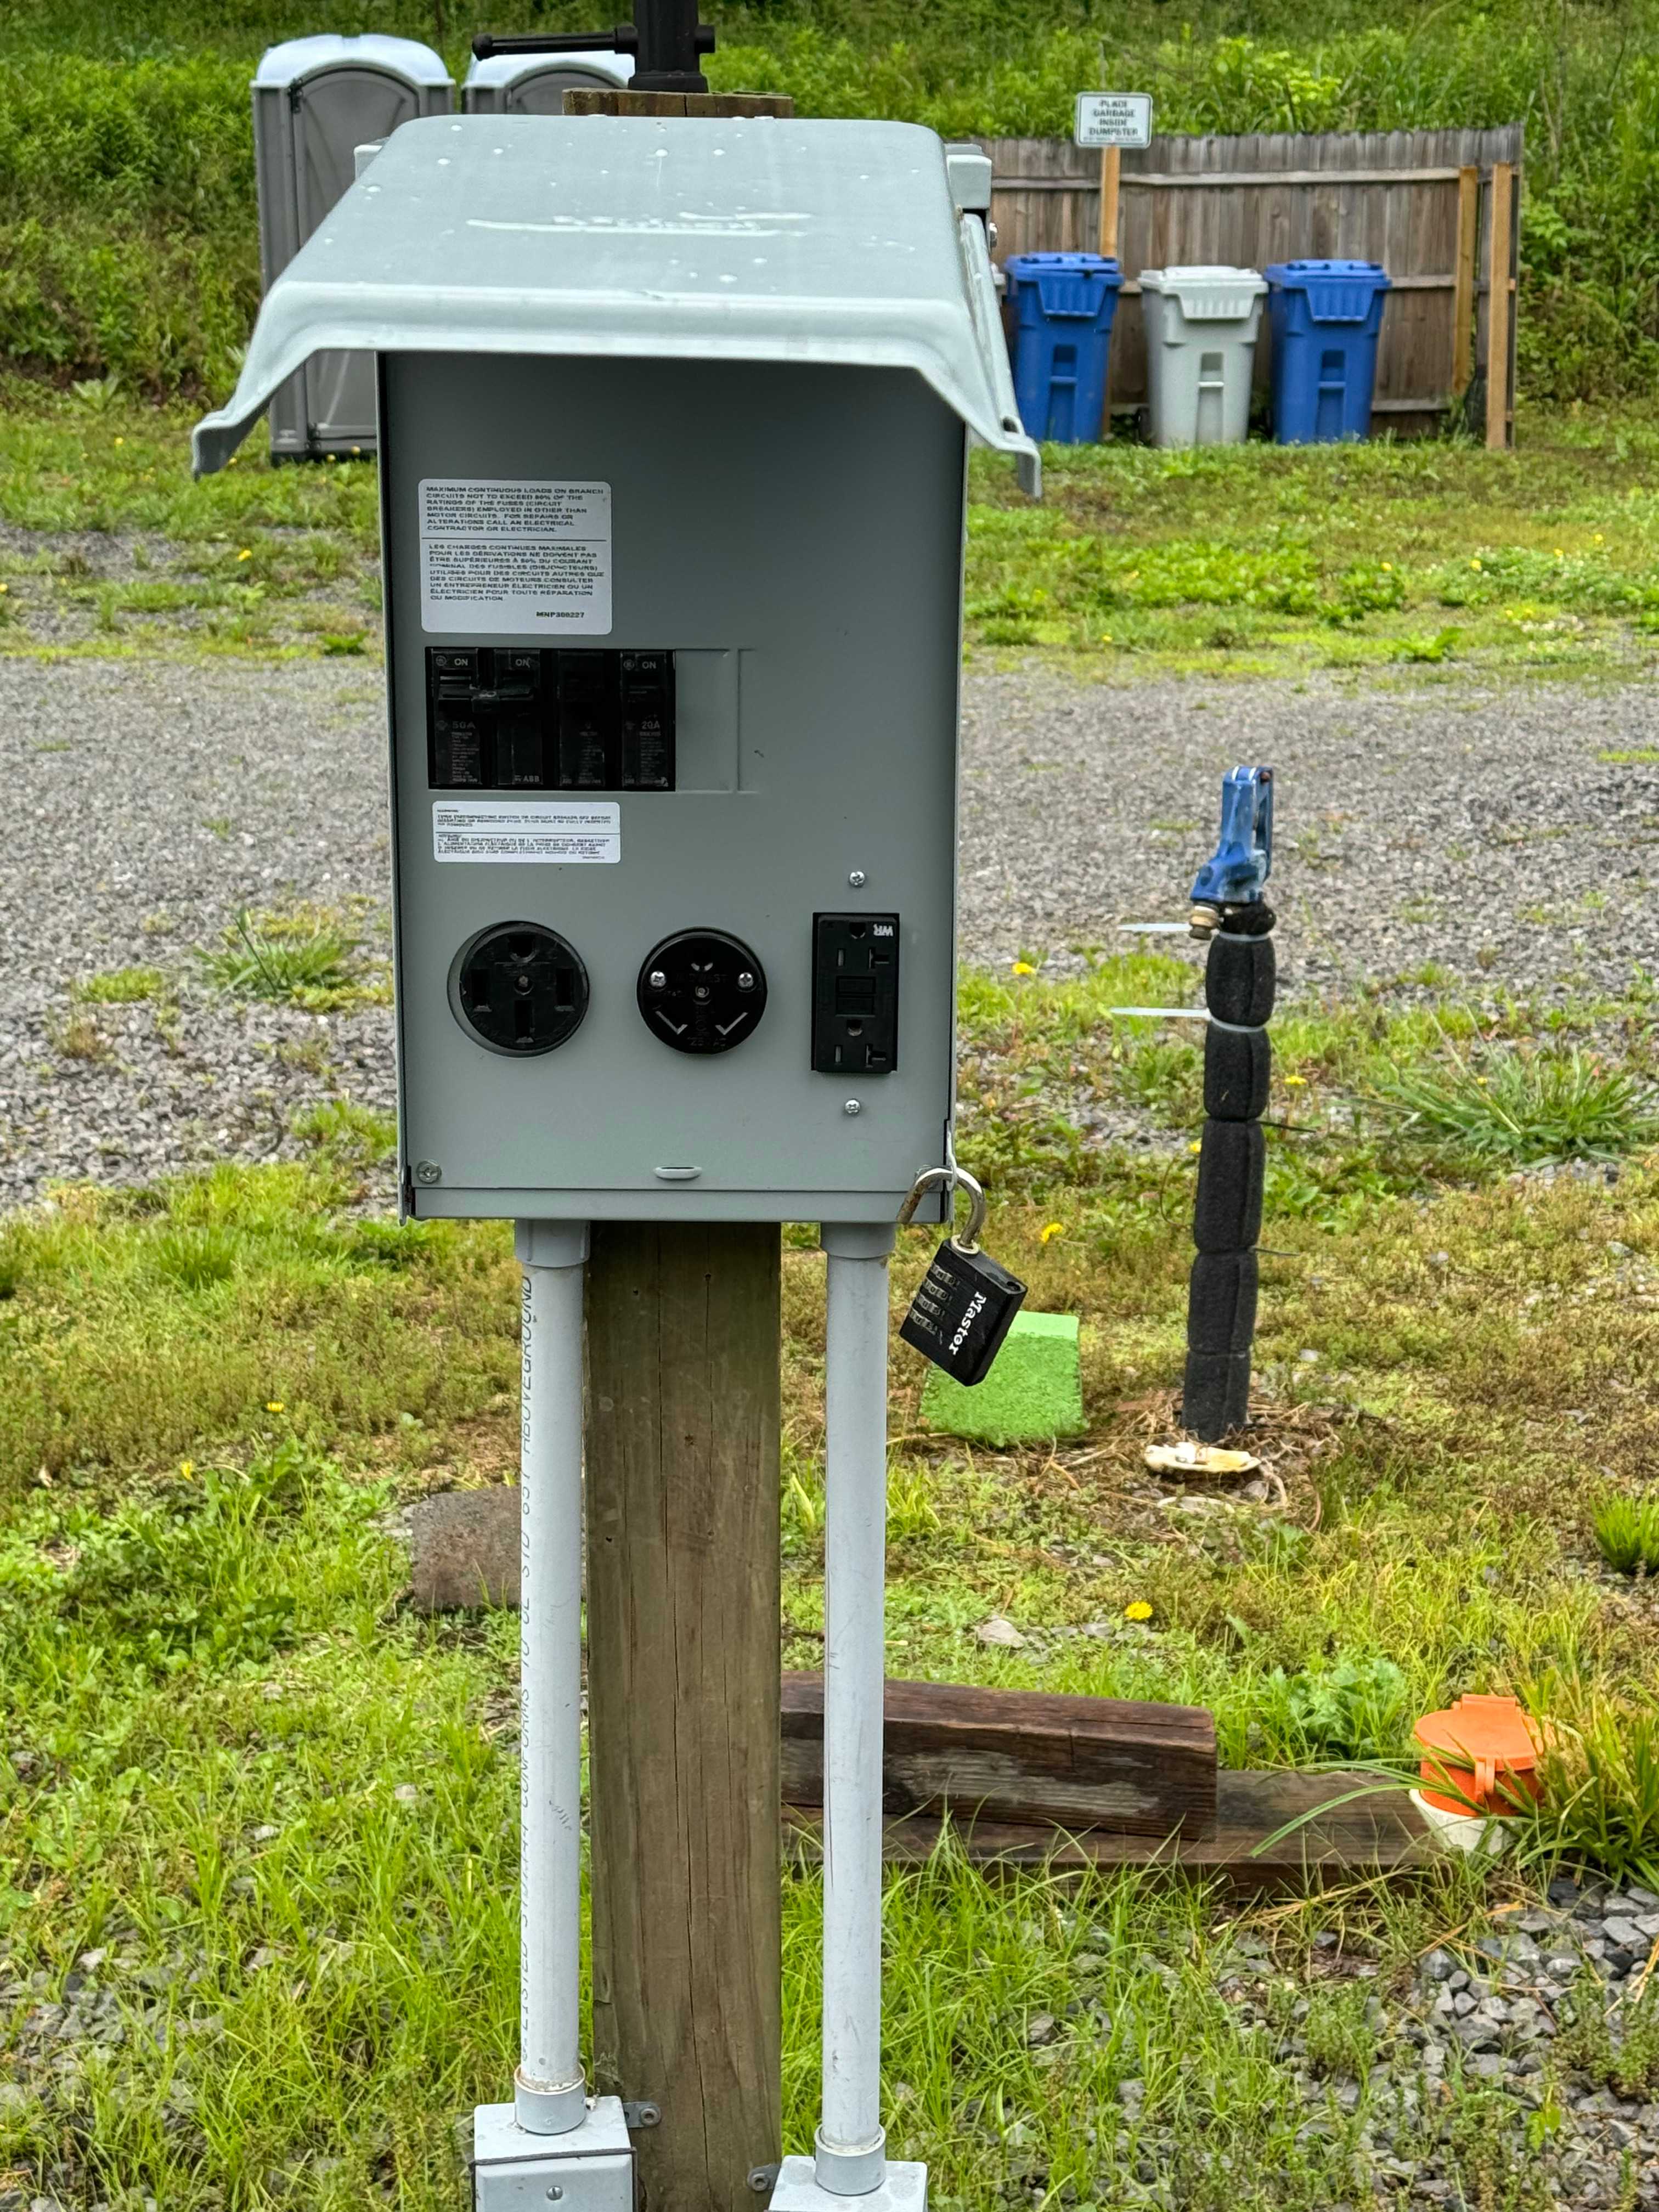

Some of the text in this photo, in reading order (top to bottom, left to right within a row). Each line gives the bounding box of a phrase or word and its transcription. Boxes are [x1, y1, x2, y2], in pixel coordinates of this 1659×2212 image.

[454, 658, 469, 667] ON
[515, 658, 529, 667] ON
[642, 661, 657, 669] ON
[452, 720, 476, 730] 50A
[641, 720, 661, 730] 20A
[873, 924, 894, 936] WR
[949, 1291, 987, 1356] Master
[522, 1276, 532, 1454] ABOVEGROUND
